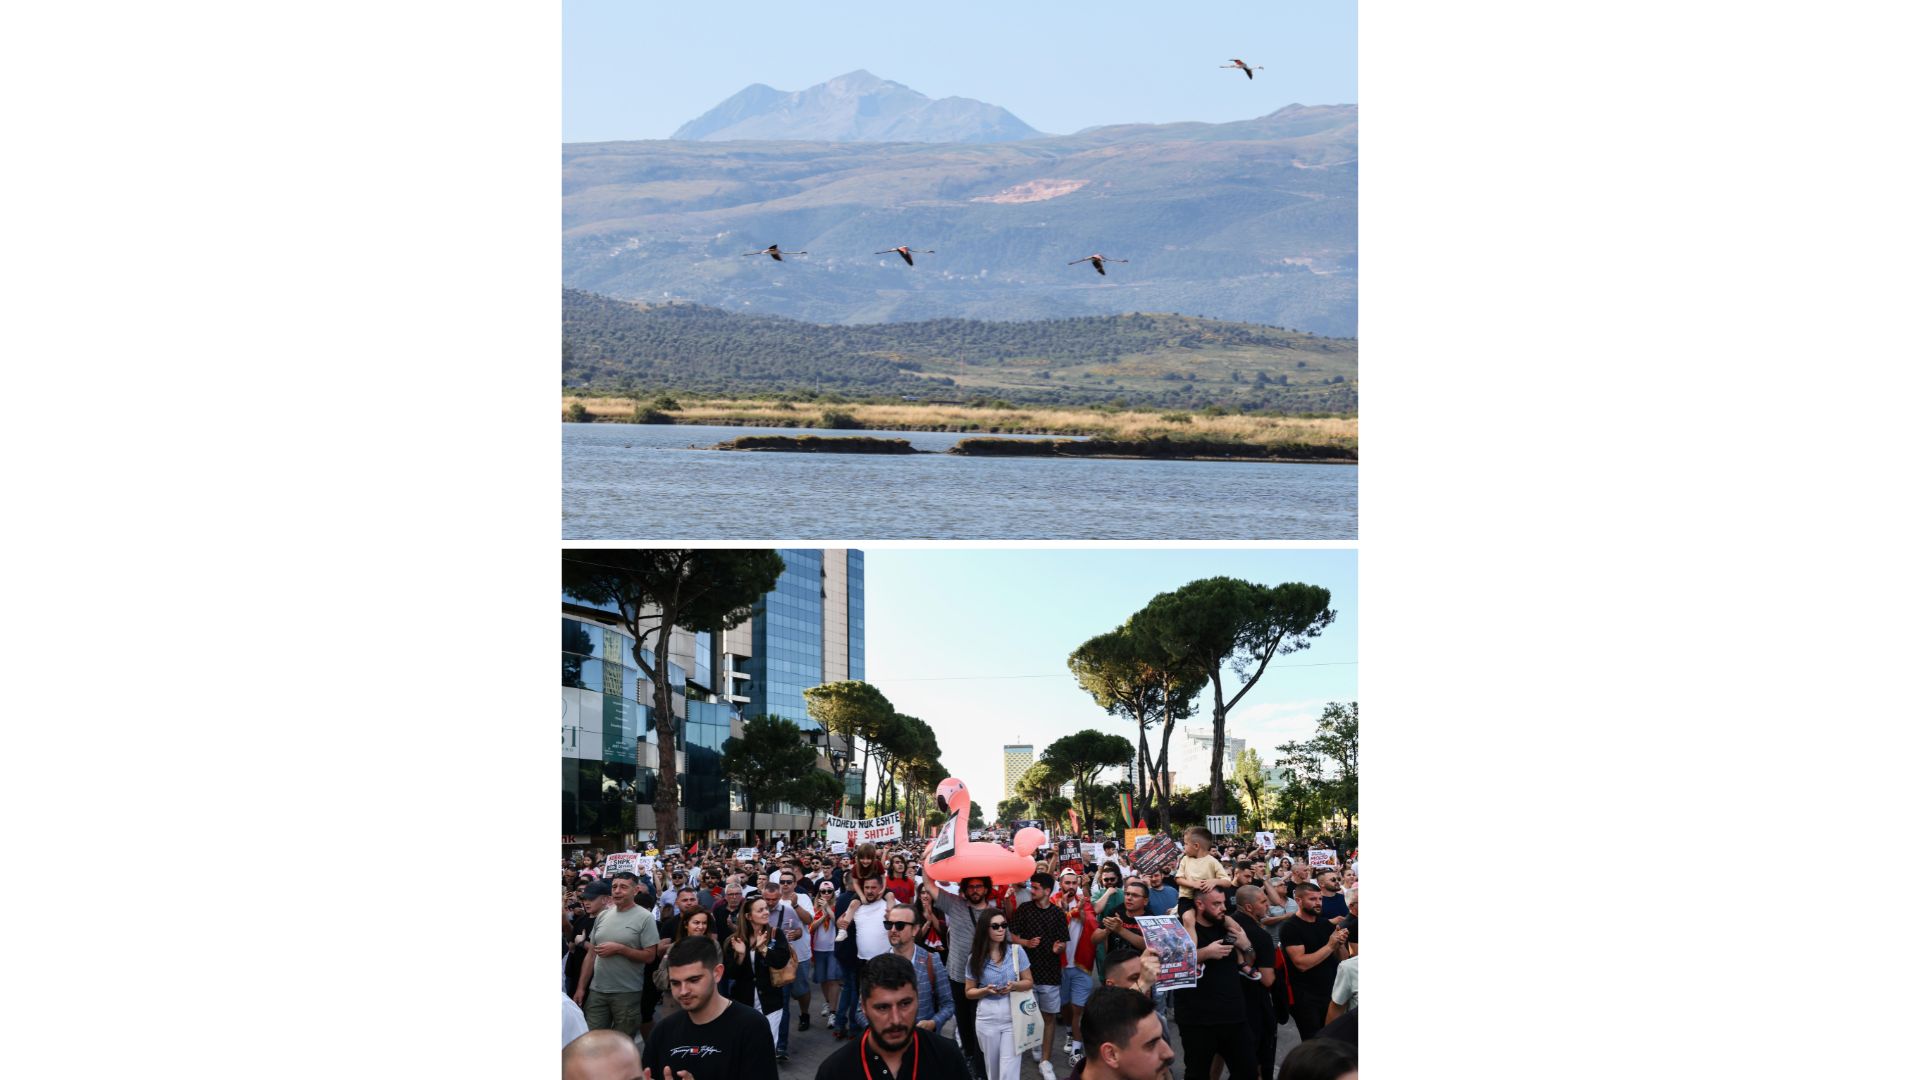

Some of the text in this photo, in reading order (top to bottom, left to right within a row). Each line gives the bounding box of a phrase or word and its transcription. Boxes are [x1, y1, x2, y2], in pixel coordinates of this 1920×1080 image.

[827, 817, 856, 828] ATDHEU
[858, 820, 873, 828] NUK
[864, 826, 895, 839] SHITJE
